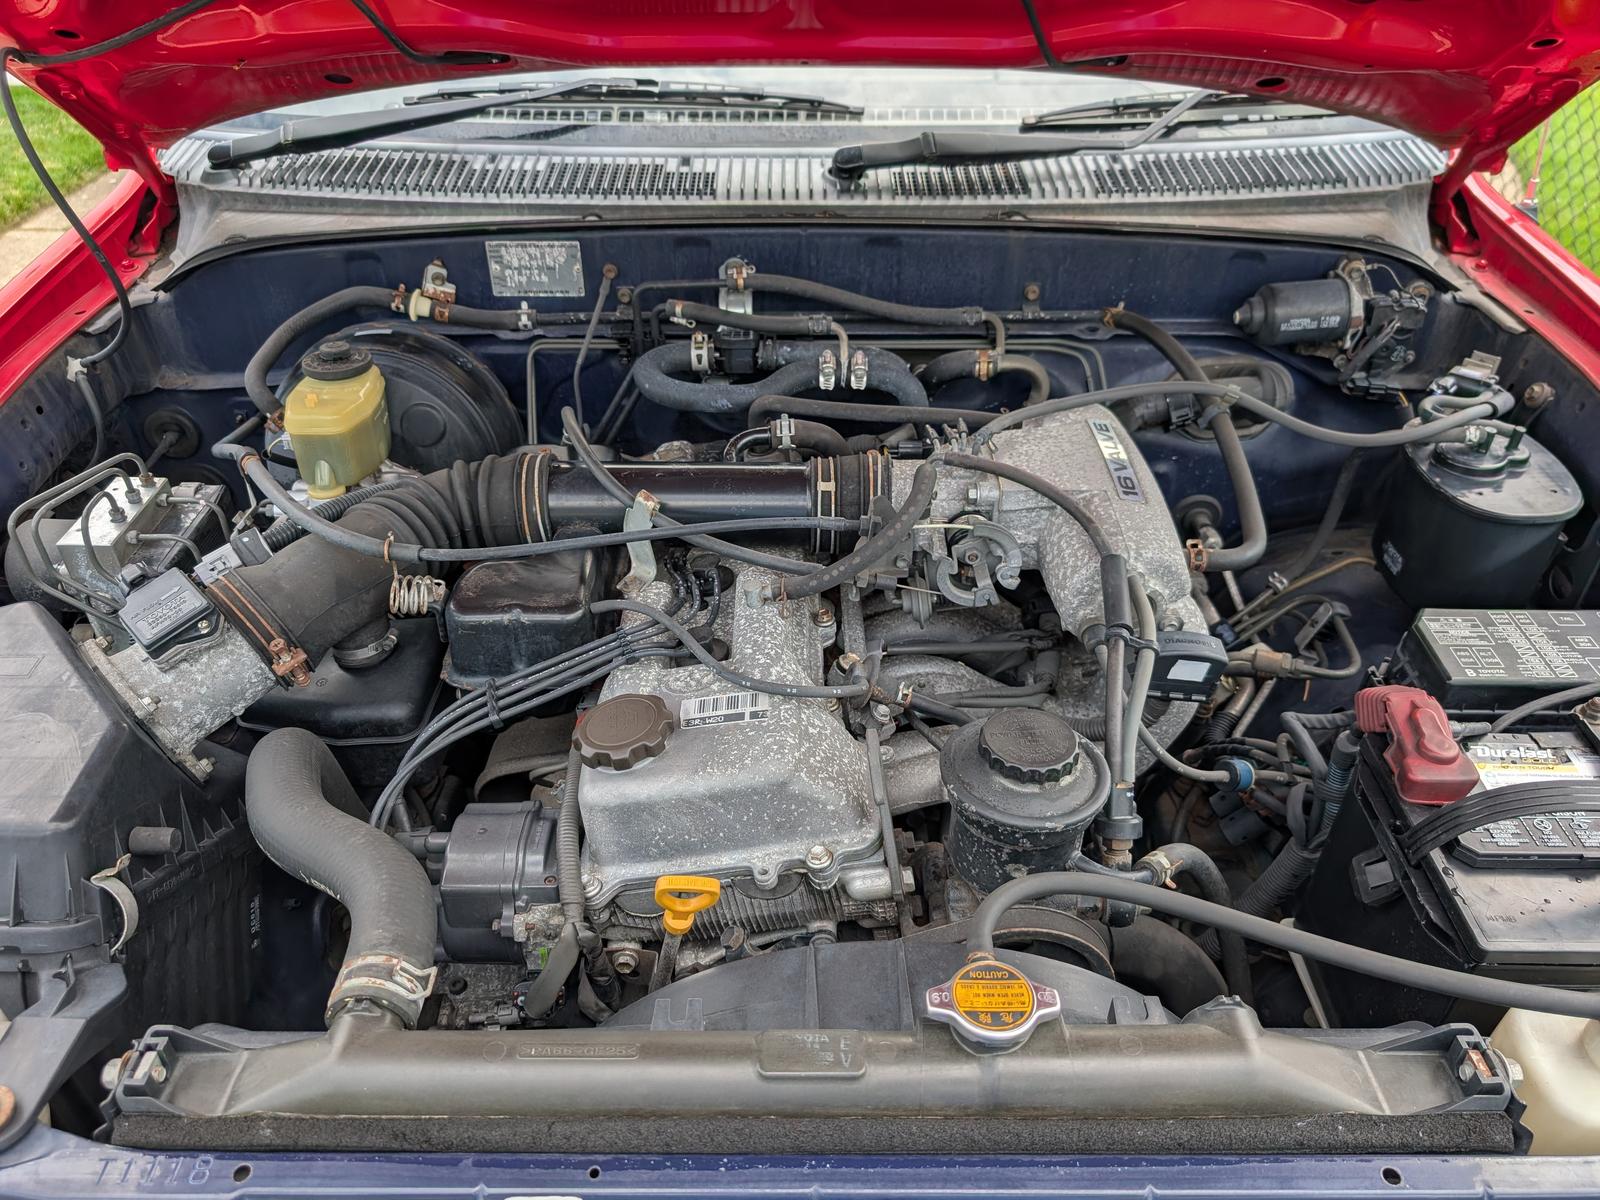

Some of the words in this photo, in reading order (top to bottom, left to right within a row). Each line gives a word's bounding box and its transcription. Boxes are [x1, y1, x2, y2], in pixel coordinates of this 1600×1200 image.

[1092, 421, 1128, 472] VALVE
[1117, 475, 1139, 497] 16
[143, 595, 186, 623] TOYOTA
[1465, 669, 1477, 677] B
[1470, 746, 1557, 759] Duralast
[969, 970, 1008, 978] CAUTION
[931, 992, 950, 1003] 0.9
